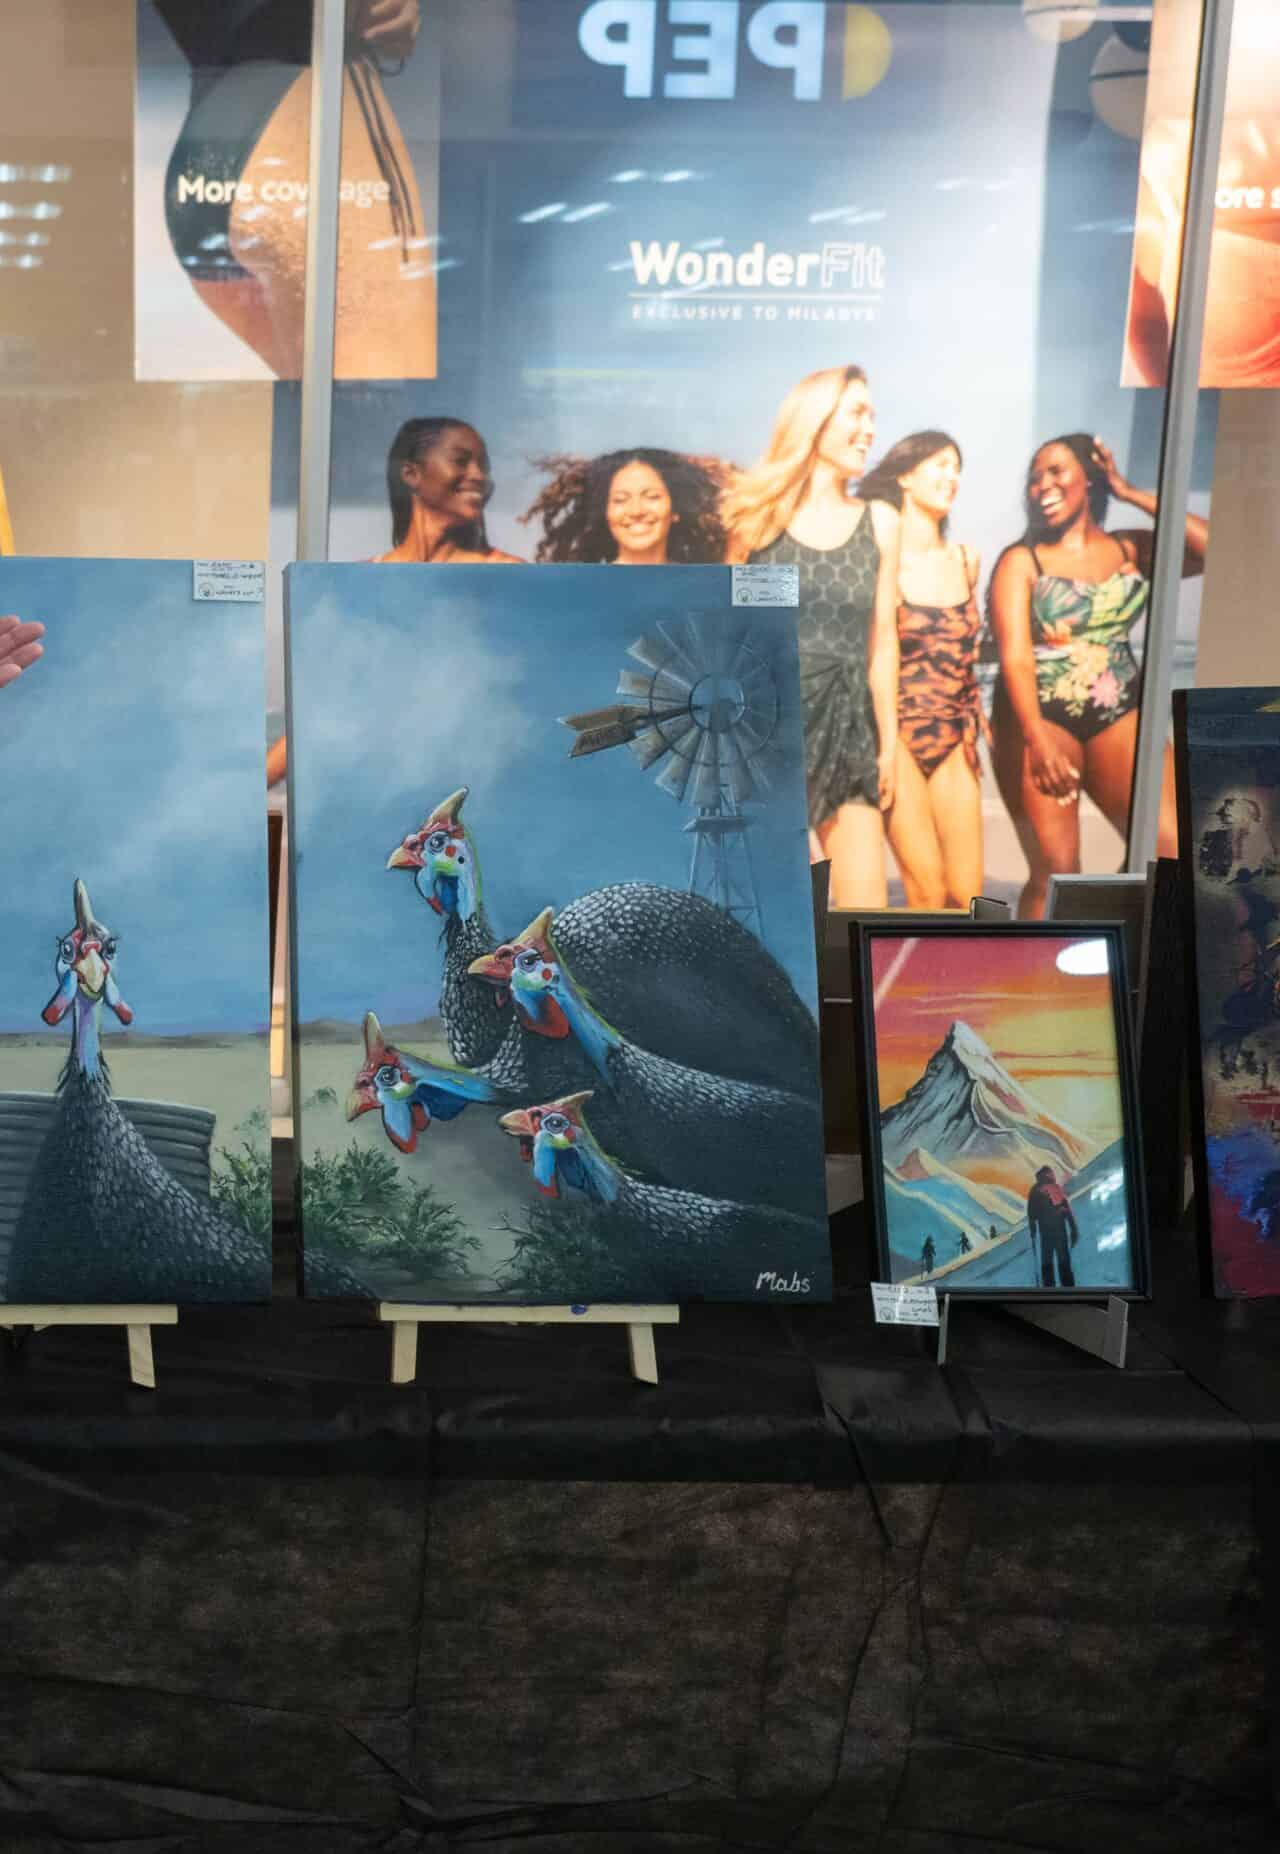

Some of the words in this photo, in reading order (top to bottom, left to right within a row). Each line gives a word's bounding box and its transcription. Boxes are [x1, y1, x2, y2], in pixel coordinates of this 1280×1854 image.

[177, 174, 255, 205] More
[259, 178, 390, 209] covage
[1214, 186, 1265, 209] ore
[629, 241, 887, 288] WonderFit
[752, 304, 778, 320] TO
[756, 1270, 811, 1293] Mabs
